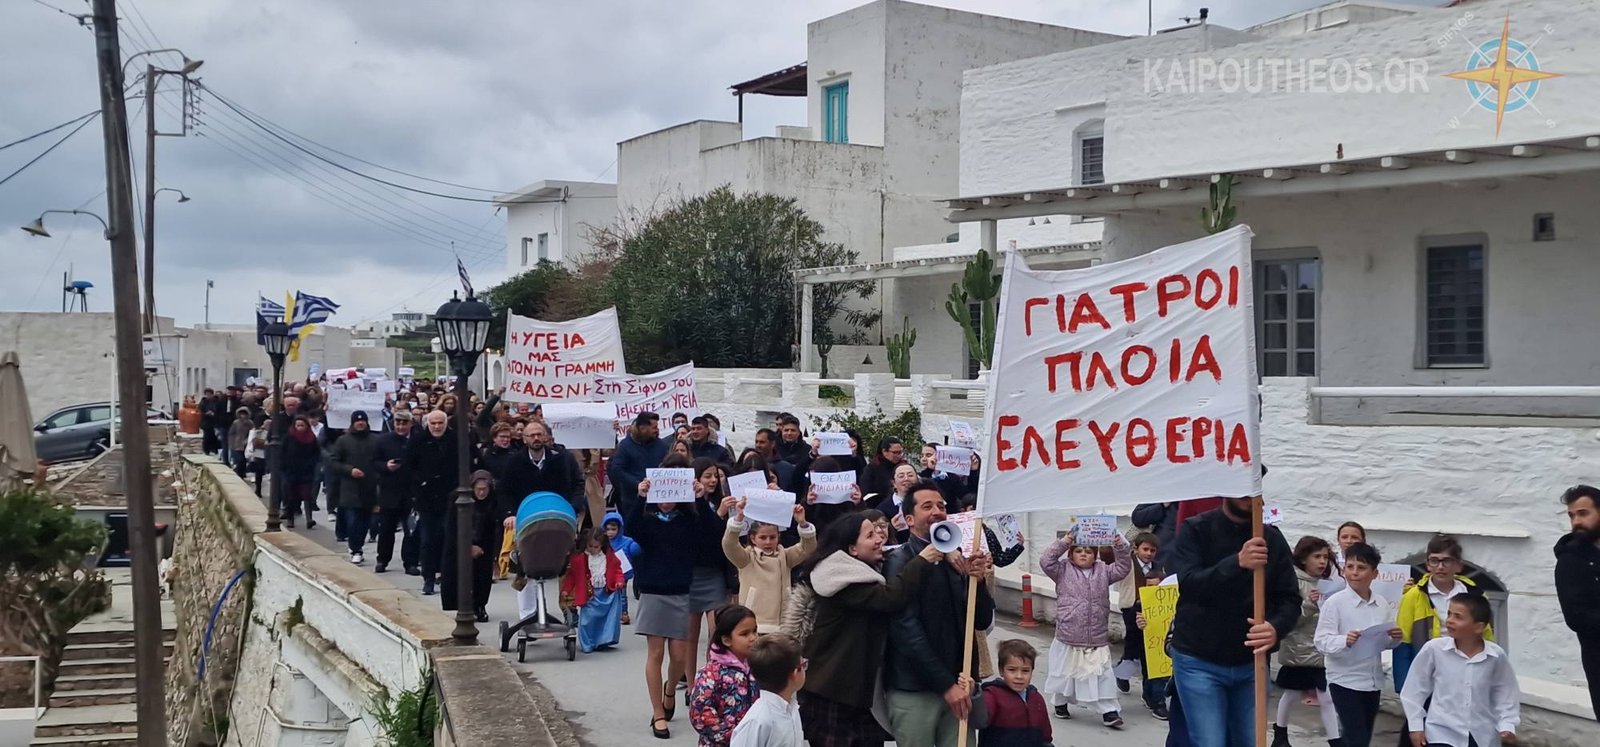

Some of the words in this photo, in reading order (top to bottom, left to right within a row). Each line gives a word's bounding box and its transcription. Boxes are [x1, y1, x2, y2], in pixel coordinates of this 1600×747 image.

[1024, 265, 1239, 336] ΓΙΑΤΡΟΙ
[511, 332, 518, 345] Η
[522, 332, 586, 351] ΥΓΕΙΑ
[528, 352, 562, 362] ΜΑΣ
[554, 360, 615, 378] ΓΡΑΜΜΗ
[1044, 334, 1222, 392] ΠΛΟΙΑ
[996, 415, 1252, 472] ΕΛΕΥΘΕΡΙΑ
